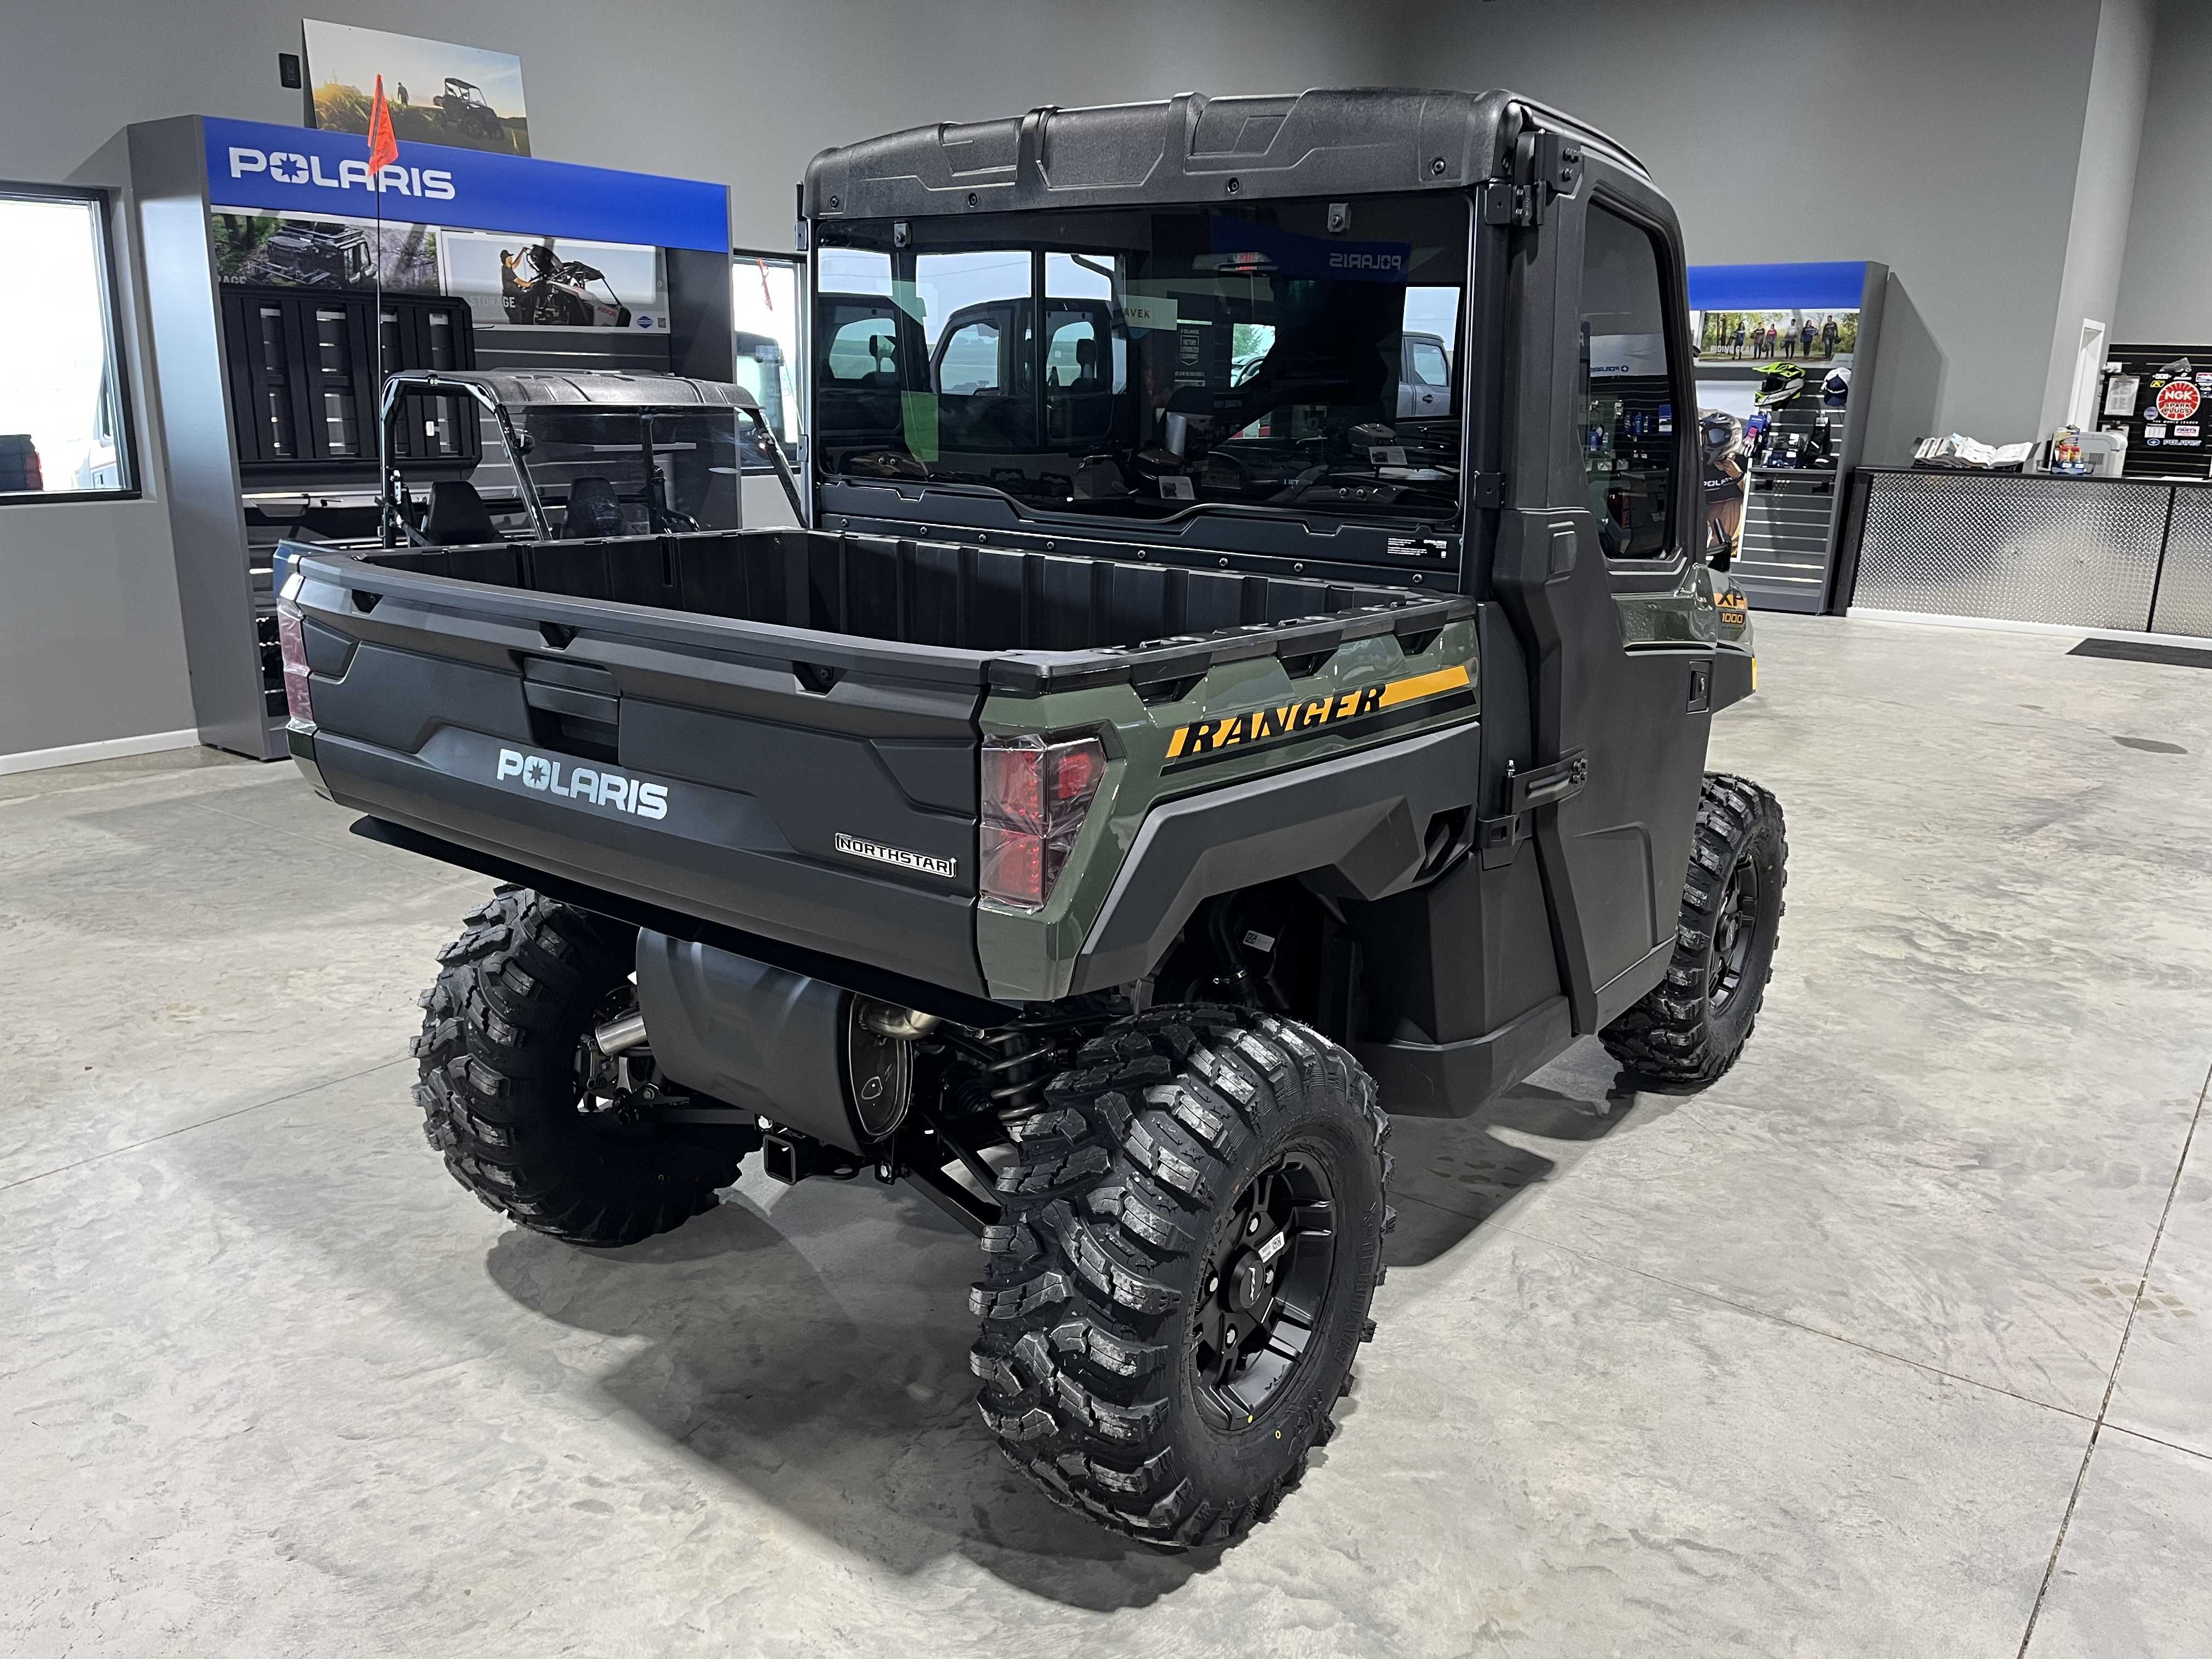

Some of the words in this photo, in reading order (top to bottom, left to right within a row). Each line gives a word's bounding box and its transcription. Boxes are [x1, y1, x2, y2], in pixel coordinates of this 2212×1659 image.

[229, 147, 455, 200] POLARIS
[469, 296, 516, 308] STORAGE
[1710, 345, 1734, 354] RIDING
[2165, 391, 2193, 400] NGK
[1718, 588, 1743, 606] XP
[1722, 613, 1743, 623] 1000
[1178, 683, 1386, 758] RANGER
[497, 748, 668, 820] POLARIS
[841, 838, 947, 872] NORTHSTAR
